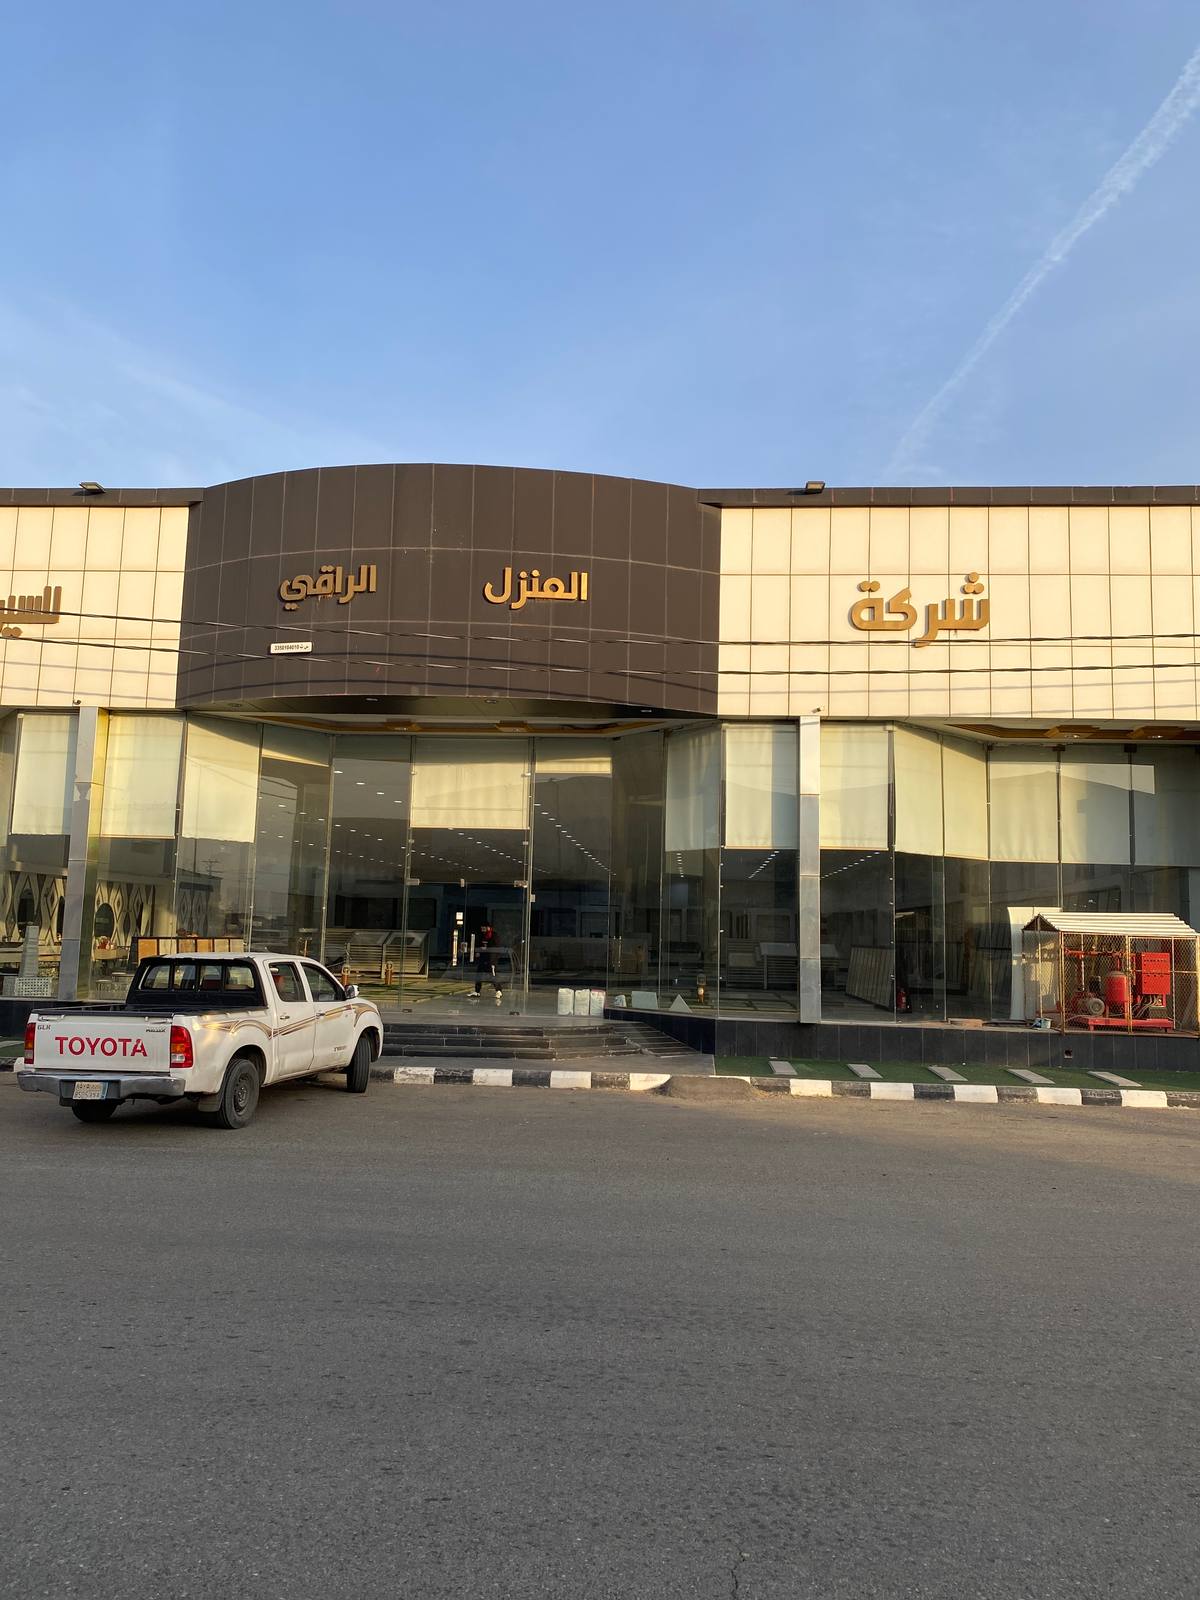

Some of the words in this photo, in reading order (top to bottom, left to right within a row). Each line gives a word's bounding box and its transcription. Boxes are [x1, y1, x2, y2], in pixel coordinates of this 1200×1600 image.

[279, 564, 378, 612] الراقي
[483, 566, 589, 610] المنزل
[848, 571, 990, 648] شركة
[55, 1036, 148, 1057] TOYOTA
